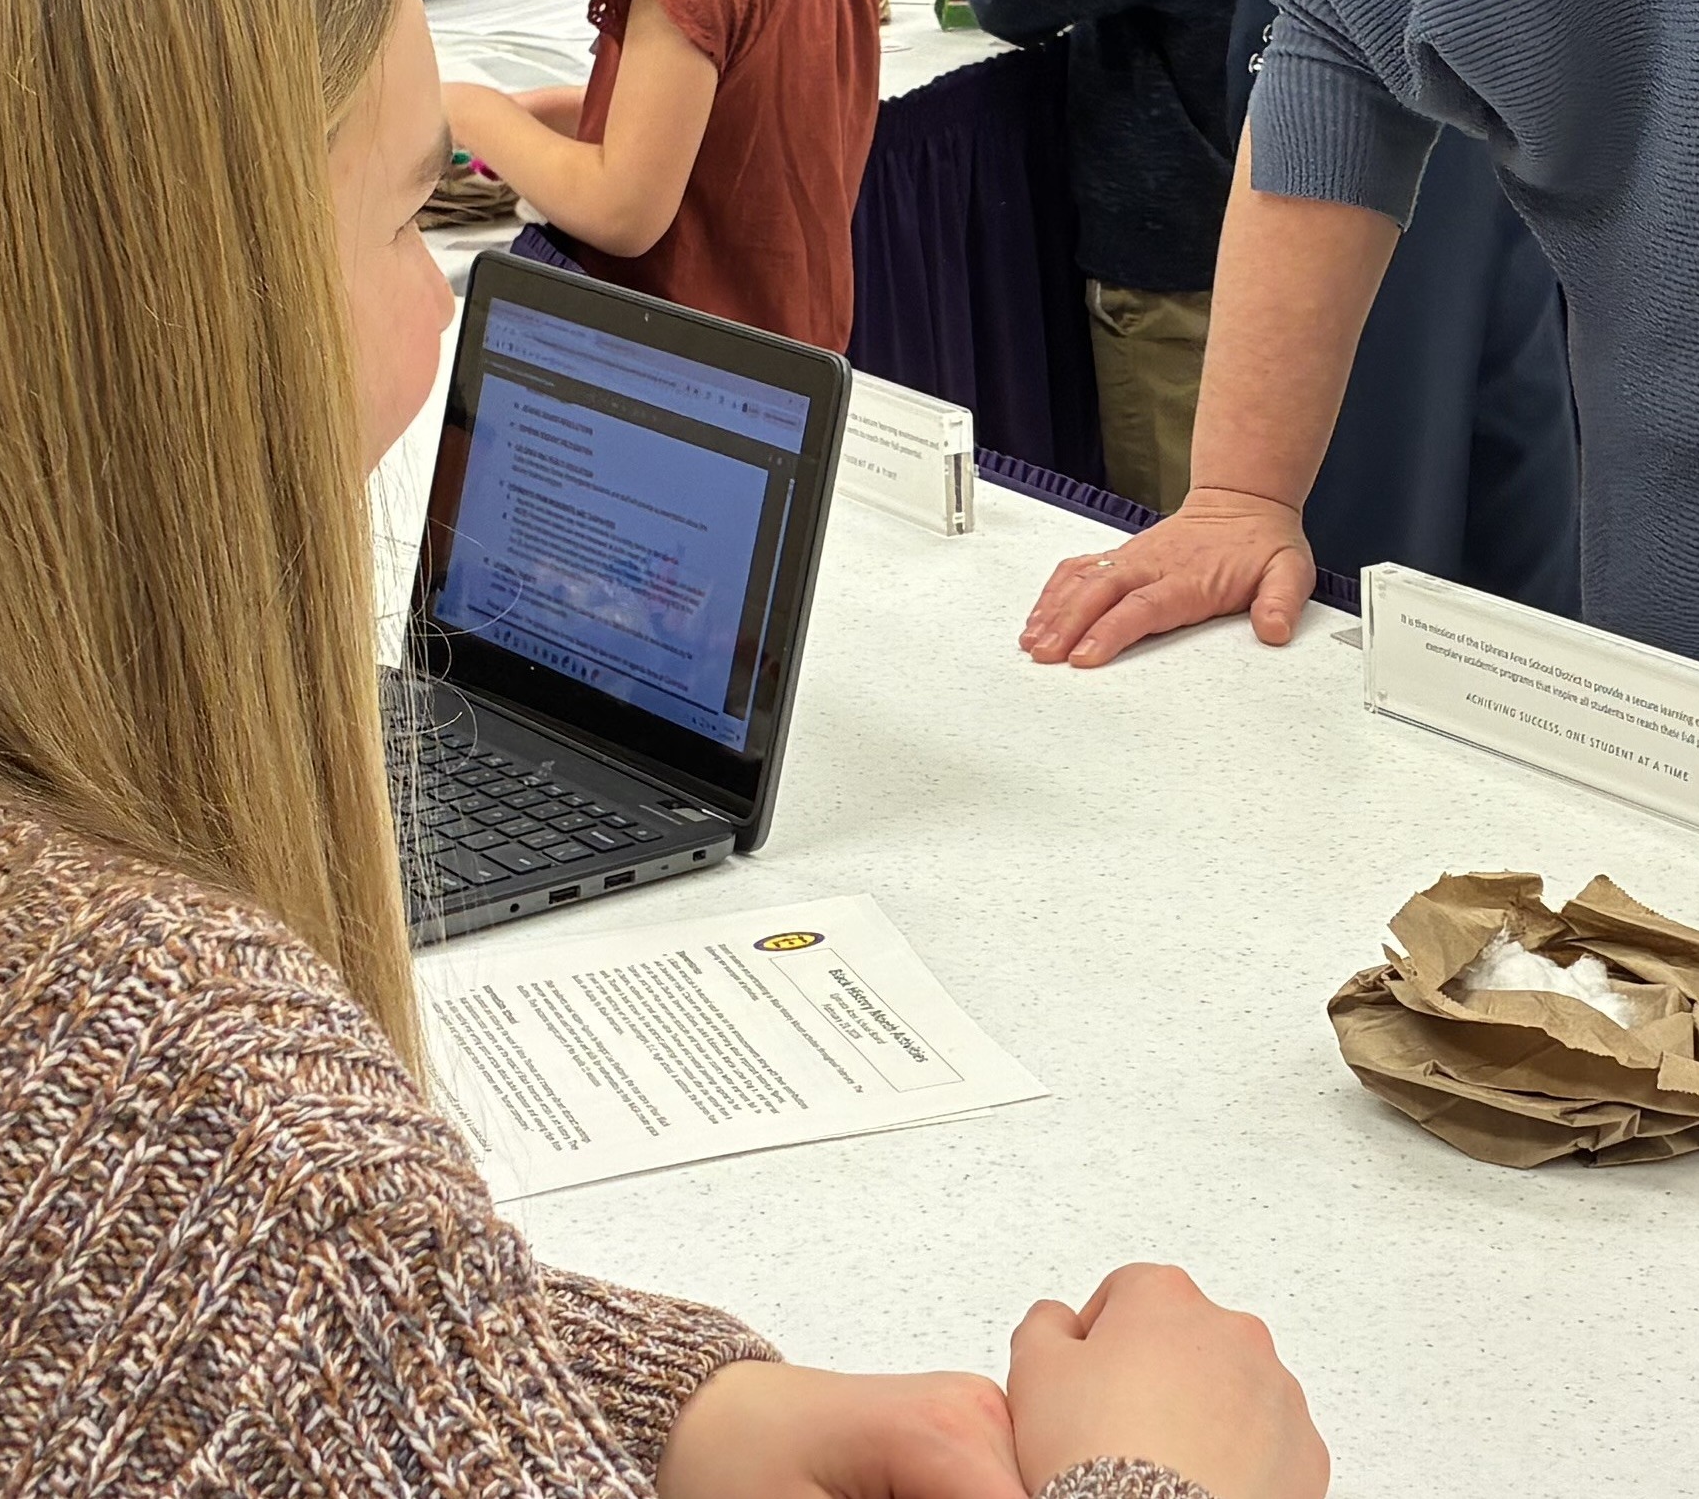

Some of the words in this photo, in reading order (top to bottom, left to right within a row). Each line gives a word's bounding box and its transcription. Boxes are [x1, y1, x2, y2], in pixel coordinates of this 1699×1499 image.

[1499, 667, 1535, 688] programs
[1535, 679, 1552, 694] that
[1579, 695, 1589, 707] all
[1625, 712, 1635, 724] to
[1636, 717, 1659, 732] reach
[1529, 658, 1554, 676] School
[1584, 678, 1593, 689] to
[1593, 683, 1624, 701] provide
[1625, 695, 1631, 703] a
[1466, 693, 1517, 718] ACHIEVING
[1519, 710, 1563, 737] SUCCESS,
[1565, 729, 1587, 744] ONE
[1589, 737, 1634, 762] STUDENT
[1637, 755, 1650, 767] AT
[1652, 760, 1660, 772] A
[1664, 764, 1689, 782] TIME
